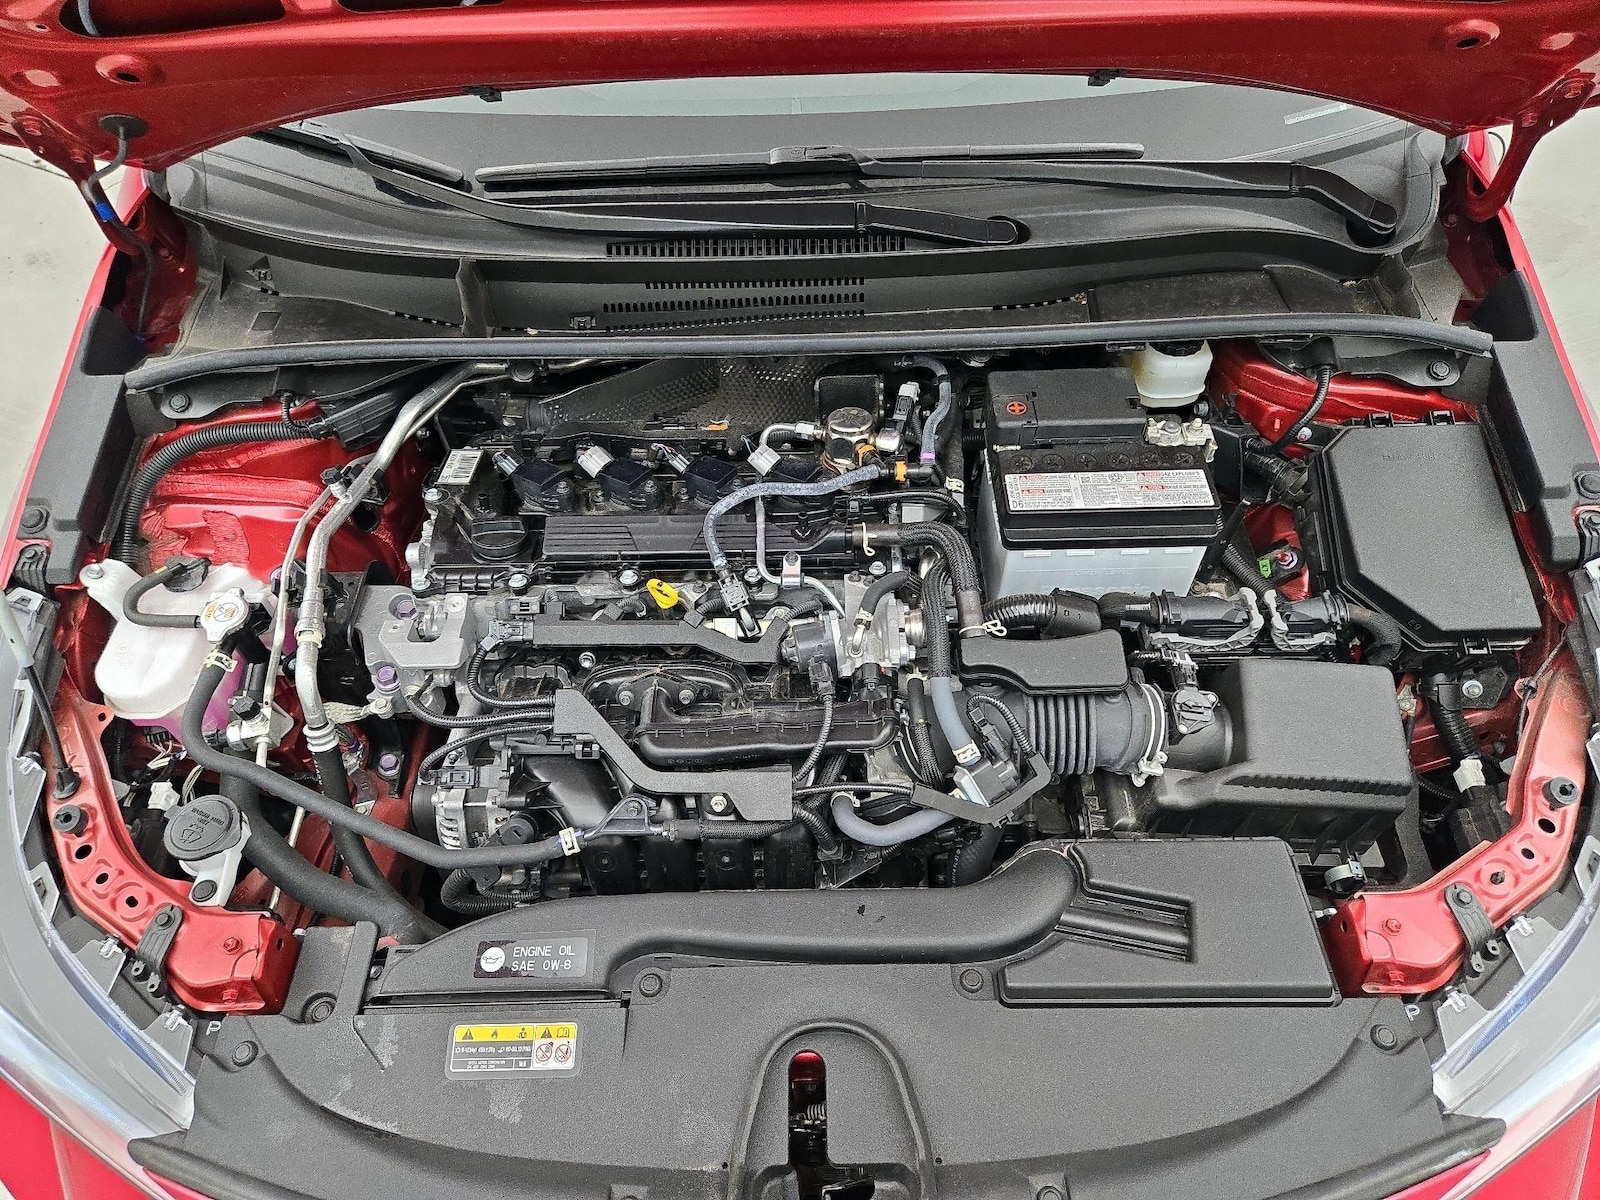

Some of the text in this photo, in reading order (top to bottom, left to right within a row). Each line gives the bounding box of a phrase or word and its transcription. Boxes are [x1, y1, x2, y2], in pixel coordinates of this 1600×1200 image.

[1012, 500, 1025, 509] D6
[513, 945, 575, 958] ENGINE OIL
[511, 959, 572, 971] SAE 0W-8
